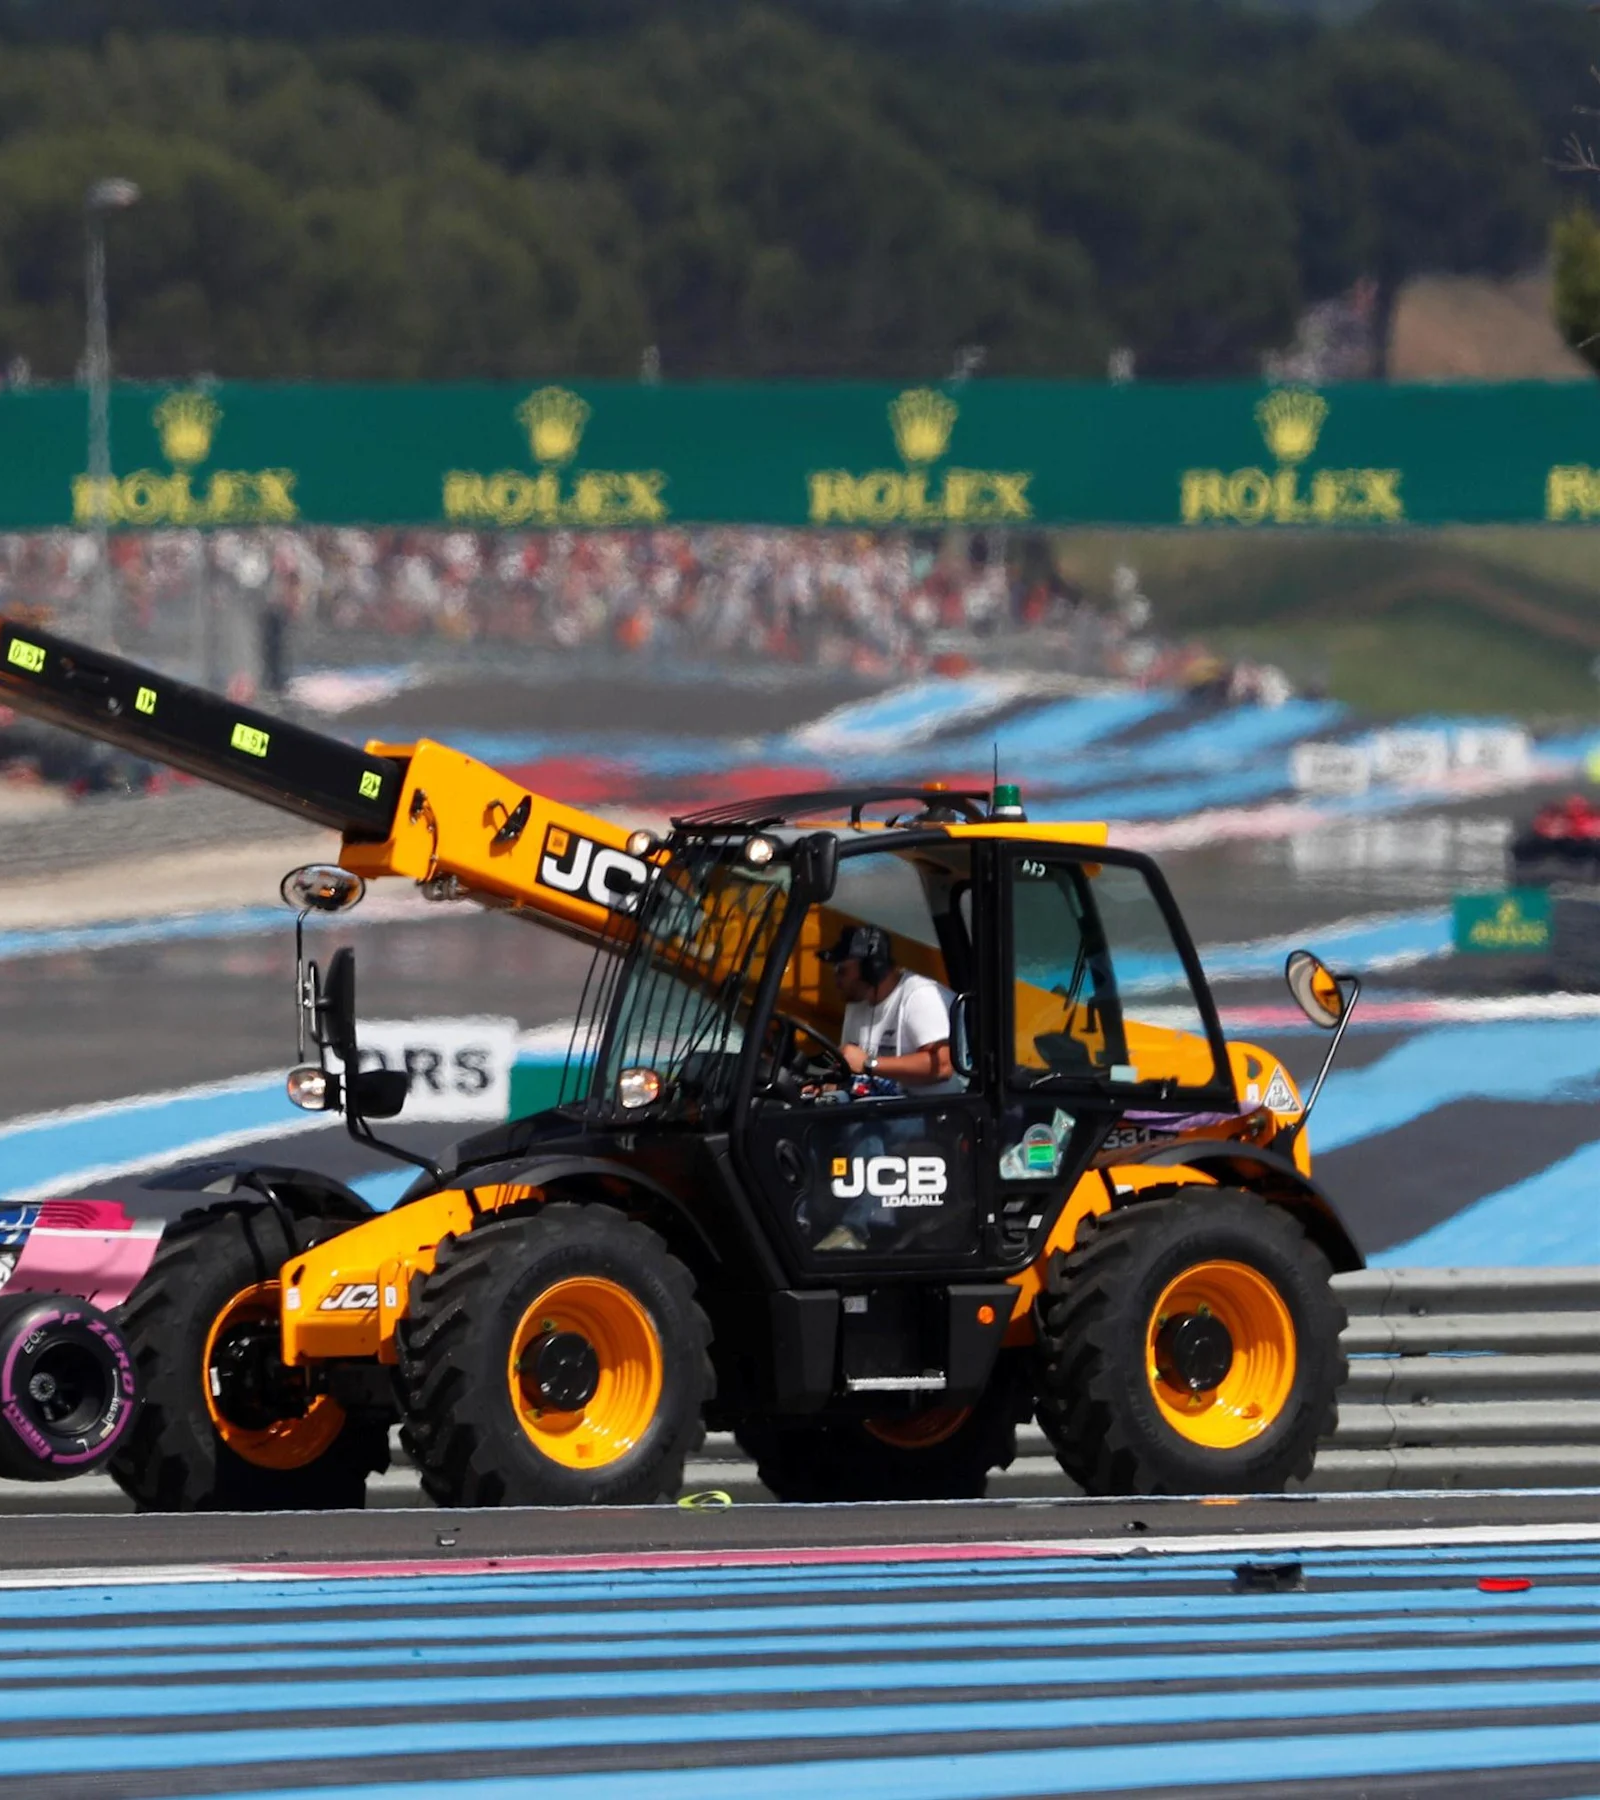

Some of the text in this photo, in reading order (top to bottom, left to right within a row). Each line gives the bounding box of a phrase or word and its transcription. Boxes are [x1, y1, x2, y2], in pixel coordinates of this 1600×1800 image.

[72, 468, 297, 524] ROLEX
[442, 468, 669, 526] ROLEX
[807, 468, 1032, 524] ROLEX
[1181, 467, 1403, 524] ROLEX
[541, 837, 660, 912] JC
[831, 1156, 947, 1198] JCB
[881, 1194, 944, 1207] LOADALL
[86, 1319, 135, 1395] ZERO
